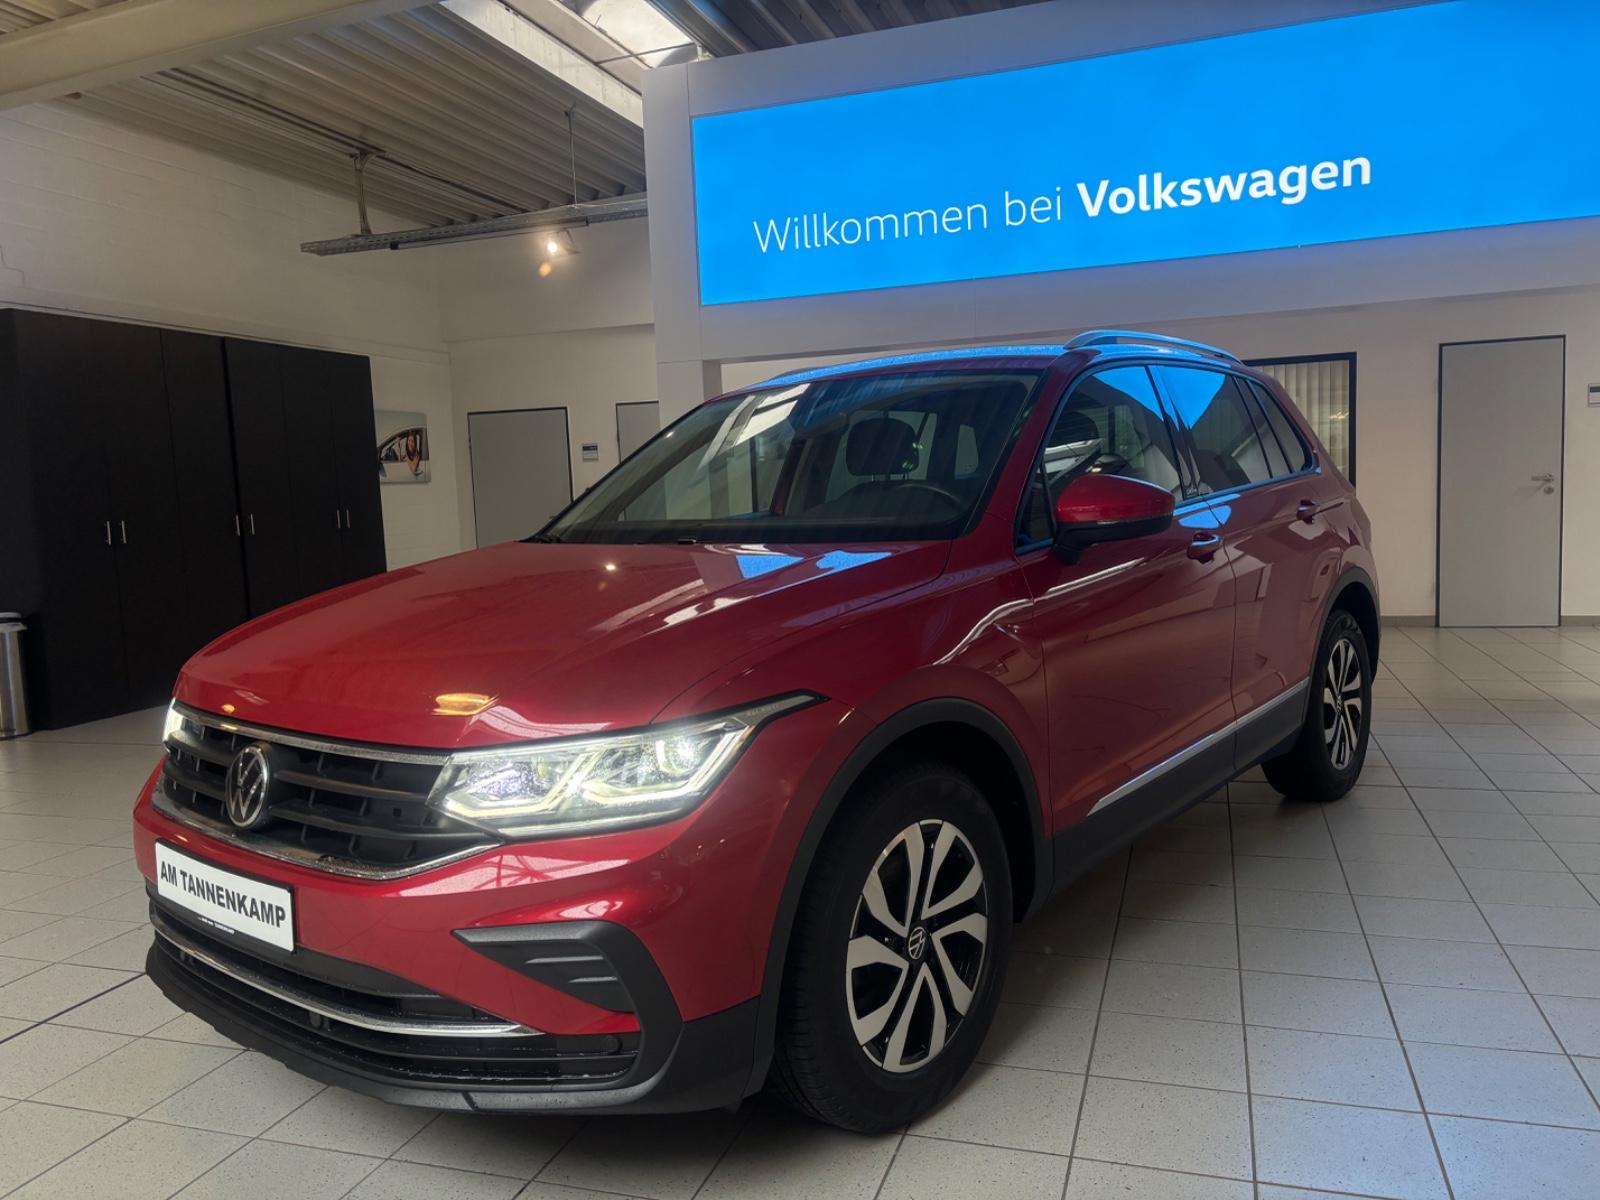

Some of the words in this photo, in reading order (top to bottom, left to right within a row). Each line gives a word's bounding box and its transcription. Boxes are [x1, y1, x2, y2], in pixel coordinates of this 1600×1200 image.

[753, 203, 988, 253] Willkommen
[1004, 187, 1061, 226] bei
[1076, 156, 1371, 217] Volkswagen
[160, 860, 178, 887] AM
[179, 870, 286, 928] TANNENKAMP
